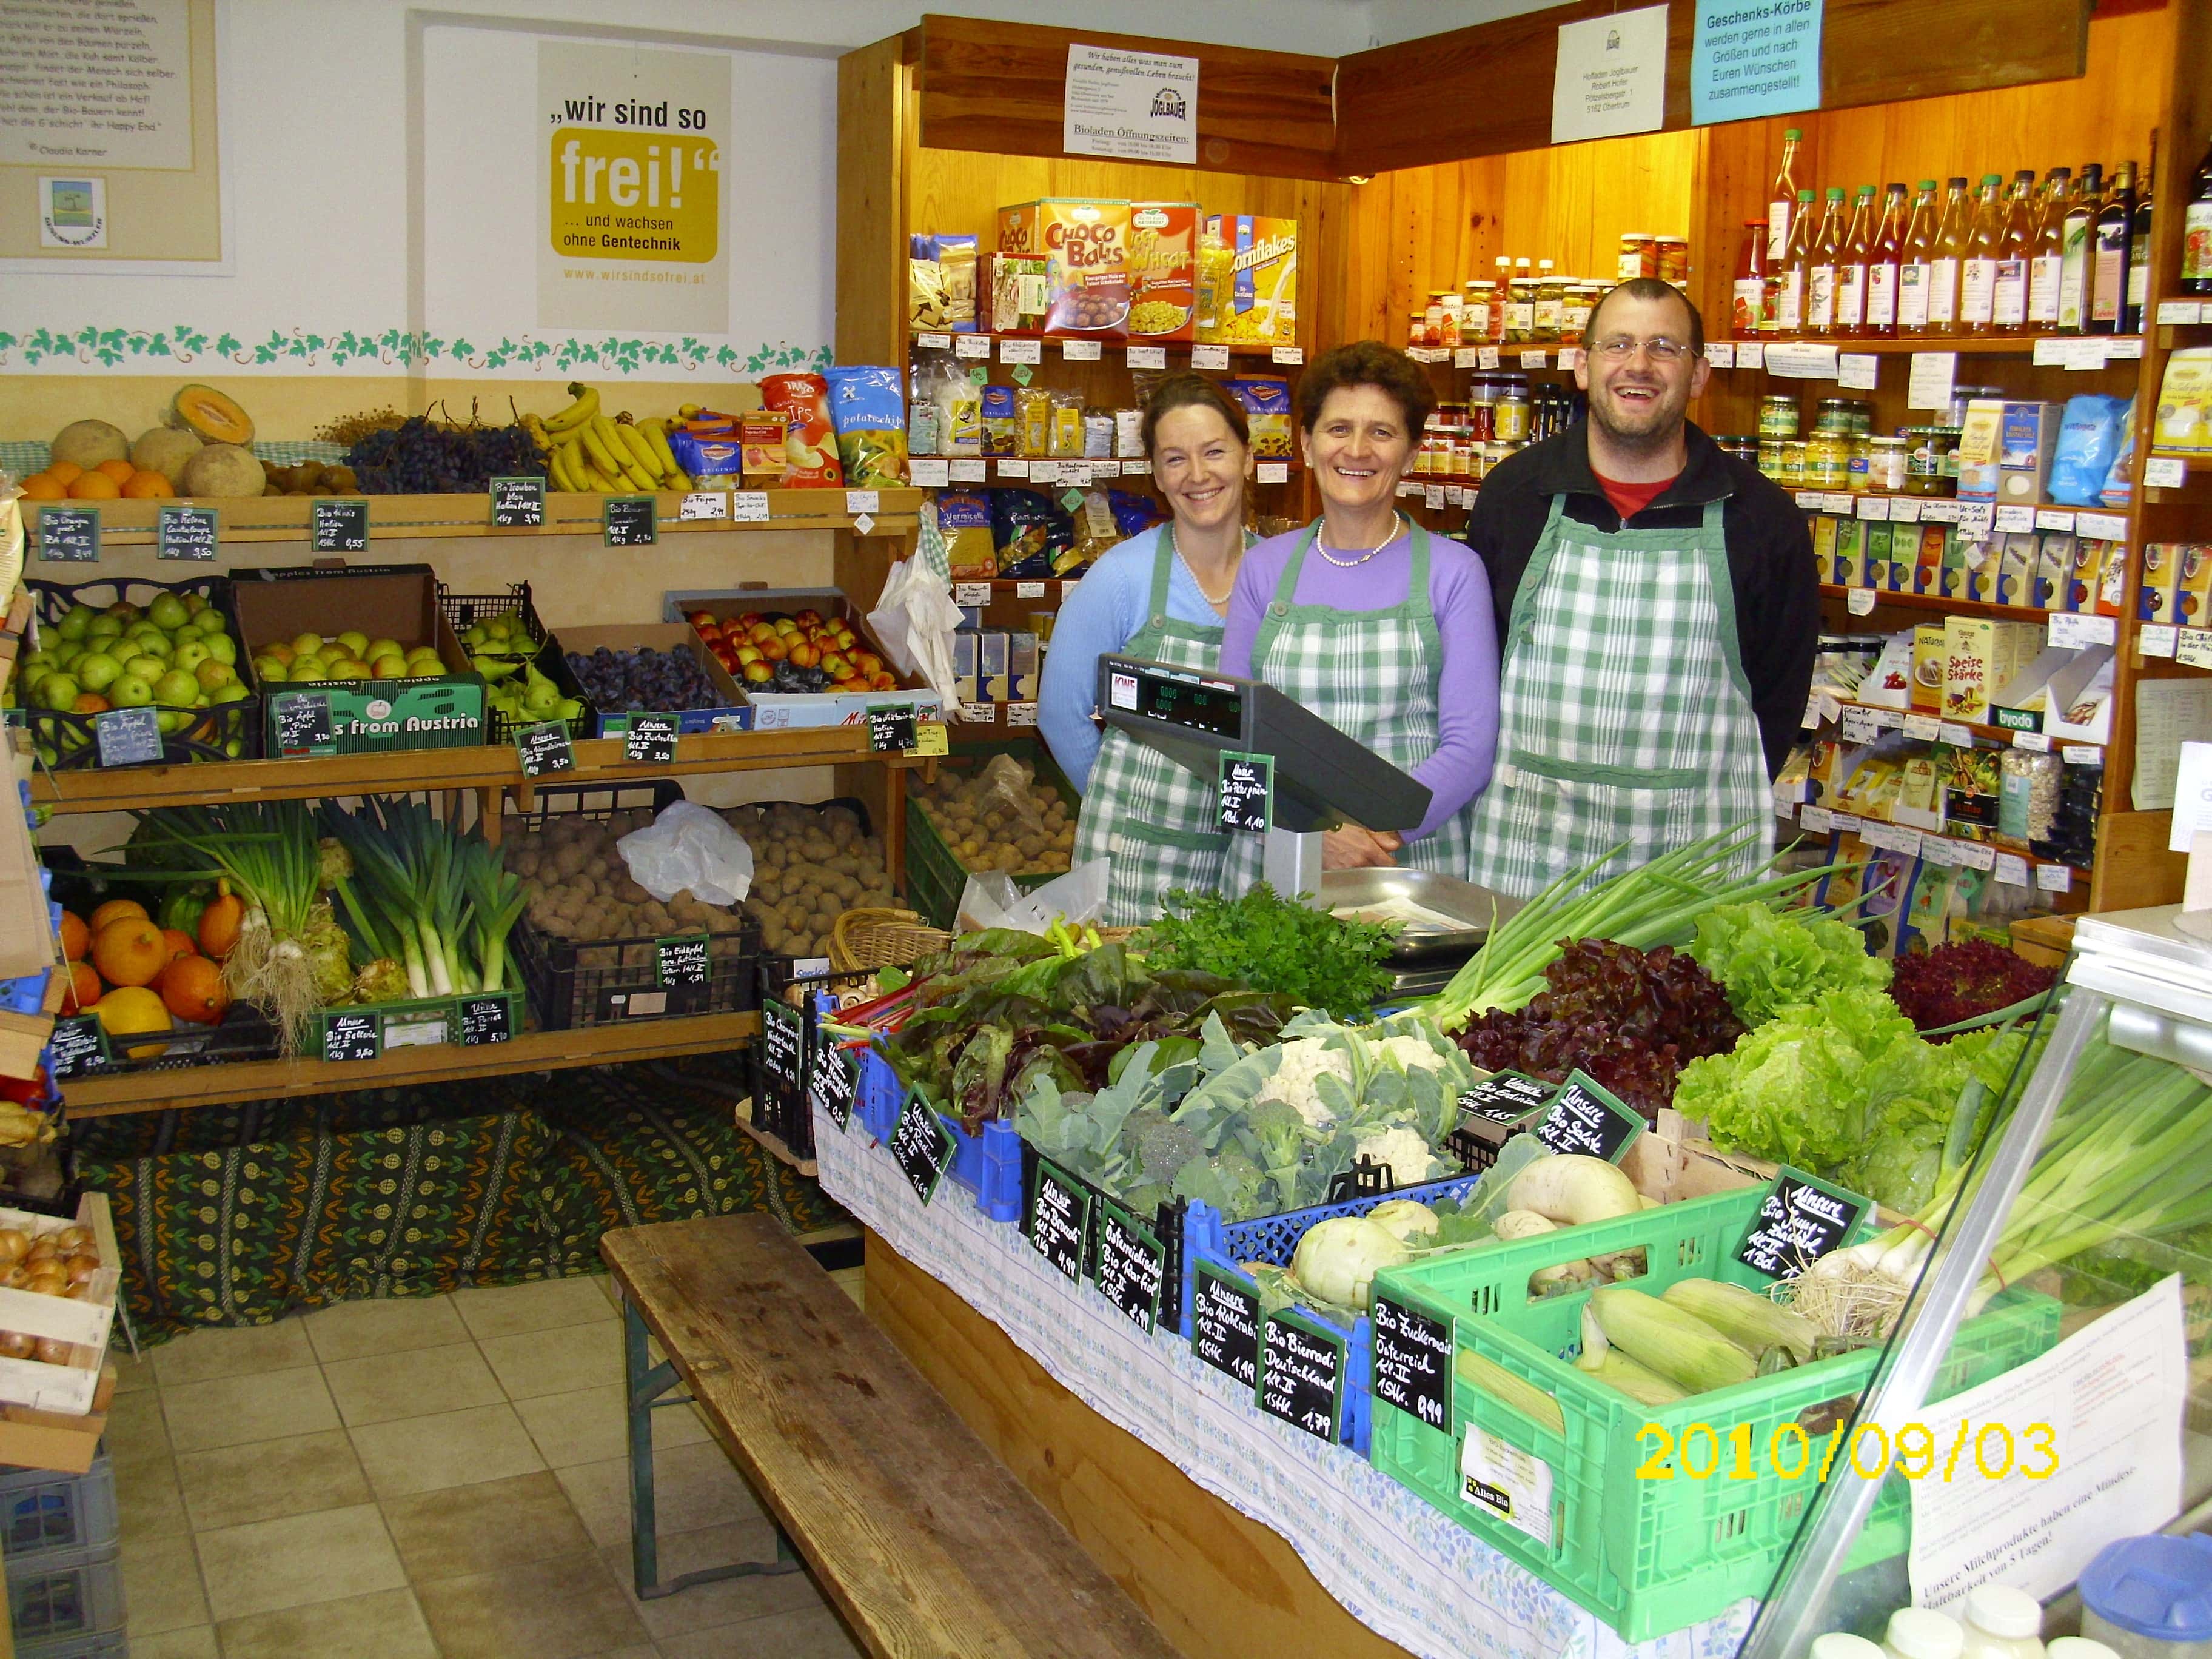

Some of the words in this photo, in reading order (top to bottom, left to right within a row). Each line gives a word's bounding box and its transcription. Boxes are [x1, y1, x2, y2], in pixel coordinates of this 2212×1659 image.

[1707, 0, 1811, 29] Geschenks-Körbe
[1704, 32, 1738, 48] werden
[1741, 28, 1770, 43] gerne
[1774, 24, 1781, 36] in
[1785, 19, 1809, 34] allen
[1102, 53, 1120, 62] haben
[1122, 56, 1136, 64] alles
[1712, 49, 1748, 63] Größen
[1752, 45, 1770, 58] und
[1774, 39, 1797, 54] nach
[1583, 68, 1607, 81] Hofladen
[1609, 65, 1638, 79] Joglbauer
[1712, 67, 1740, 81] Euren
[1744, 59, 1796, 77] Wünschen
[1592, 81, 1610, 91] Robert
[1612, 78, 1628, 88] Hofer
[1708, 75, 1800, 101] zusammengestellt!
[615, 99, 667, 127] sind
[679, 107, 706, 130] so
[1602, 101, 1630, 112] Obertrum
[1074, 124, 1114, 136] Bioladen
[1118, 127, 1189, 142] Öffnungszeiten:
[586, 215, 609, 227] und
[616, 216, 672, 230] wachsen
[564, 233, 595, 247] ohne
[602, 235, 680, 251] Gentechnik
[1045, 222, 1116, 250] CHOCO
[1230, 233, 1295, 275] ornflakes
[564, 269, 705, 284] www.wirsindsofrei.at
[946, 512, 984, 521] Vermicelli
[346, 538, 364, 550] 0,55
[1949, 655, 1983, 669] Speise
[1948, 668, 1983, 681] Stärke
[351, 719, 398, 735] from
[407, 712, 478, 731] Austria
[870, 714, 882, 723] Bio
[1999, 710, 2032, 727] byodo
[628, 731, 642, 741] Bio
[552, 759, 568, 769] 3,50
[654, 752, 669, 762] 3,50
[1220, 780, 1232, 793] Bio
[1245, 816, 1264, 829] 1,10
[659, 948, 672, 957] Bio
[688, 974, 703, 983] 1,59
[766, 1011, 775, 1027] Bio
[326, 1031, 341, 1042] Bio
[344, 1029, 378, 1039] Sellerie
[490, 1032, 508, 1042] 5,90
[355, 1048, 374, 1059] 3,50
[817, 1048, 827, 1068] Bio
[1474, 1082, 1496, 1093] Bio
[1565, 1085, 1604, 1123] Unsere
[902, 1111, 913, 1133] Bio
[1547, 1105, 1566, 1129] Bio
[1566, 1121, 1603, 1155] Salate
[1042, 1178, 1071, 1209] Unser
[1791, 1185, 1843, 1218] Unsere
[1036, 1197, 1050, 1221] Bio
[1760, 1196, 1785, 1219] Bio
[1057, 1249, 1076, 1277] 4,99
[1102, 1243, 1119, 1269] Bio
[1122, 1259, 1158, 1297] Karfiol
[1209, 1279, 1245, 1310] Unsere
[1128, 1303, 1150, 1331] 2,99
[1196, 1293, 1214, 1317] Bio
[1215, 1307, 1259, 1340] Kohlrabi
[1265, 1321, 1285, 1347] Bio
[1375, 1302, 1397, 1329] Bio
[1397, 1309, 1452, 1356] Zuckermais
[1376, 1332, 1435, 1375] Österreich
[1231, 1356, 1255, 1384] 1,19
[1264, 1347, 1335, 1394] Deutschland
[1418, 1394, 1443, 1424] 0,99
[1301, 1411, 1331, 1436] 1,79
[1474, 1486, 1495, 1501] Alles
[1496, 1492, 1509, 1507] Bio
[1923, 1570, 1961, 1598] Unsere
[1964, 1523, 2038, 1573] Milchprodukte
[2040, 1504, 2071, 1527] haben
[2073, 1492, 2093, 1509] eine
[2096, 1466, 2137, 1495] Mindest-
[1989, 1564, 2008, 1578] von
[2009, 1555, 2016, 1566] 5
[2018, 1531, 2053, 1560] Tagen!
